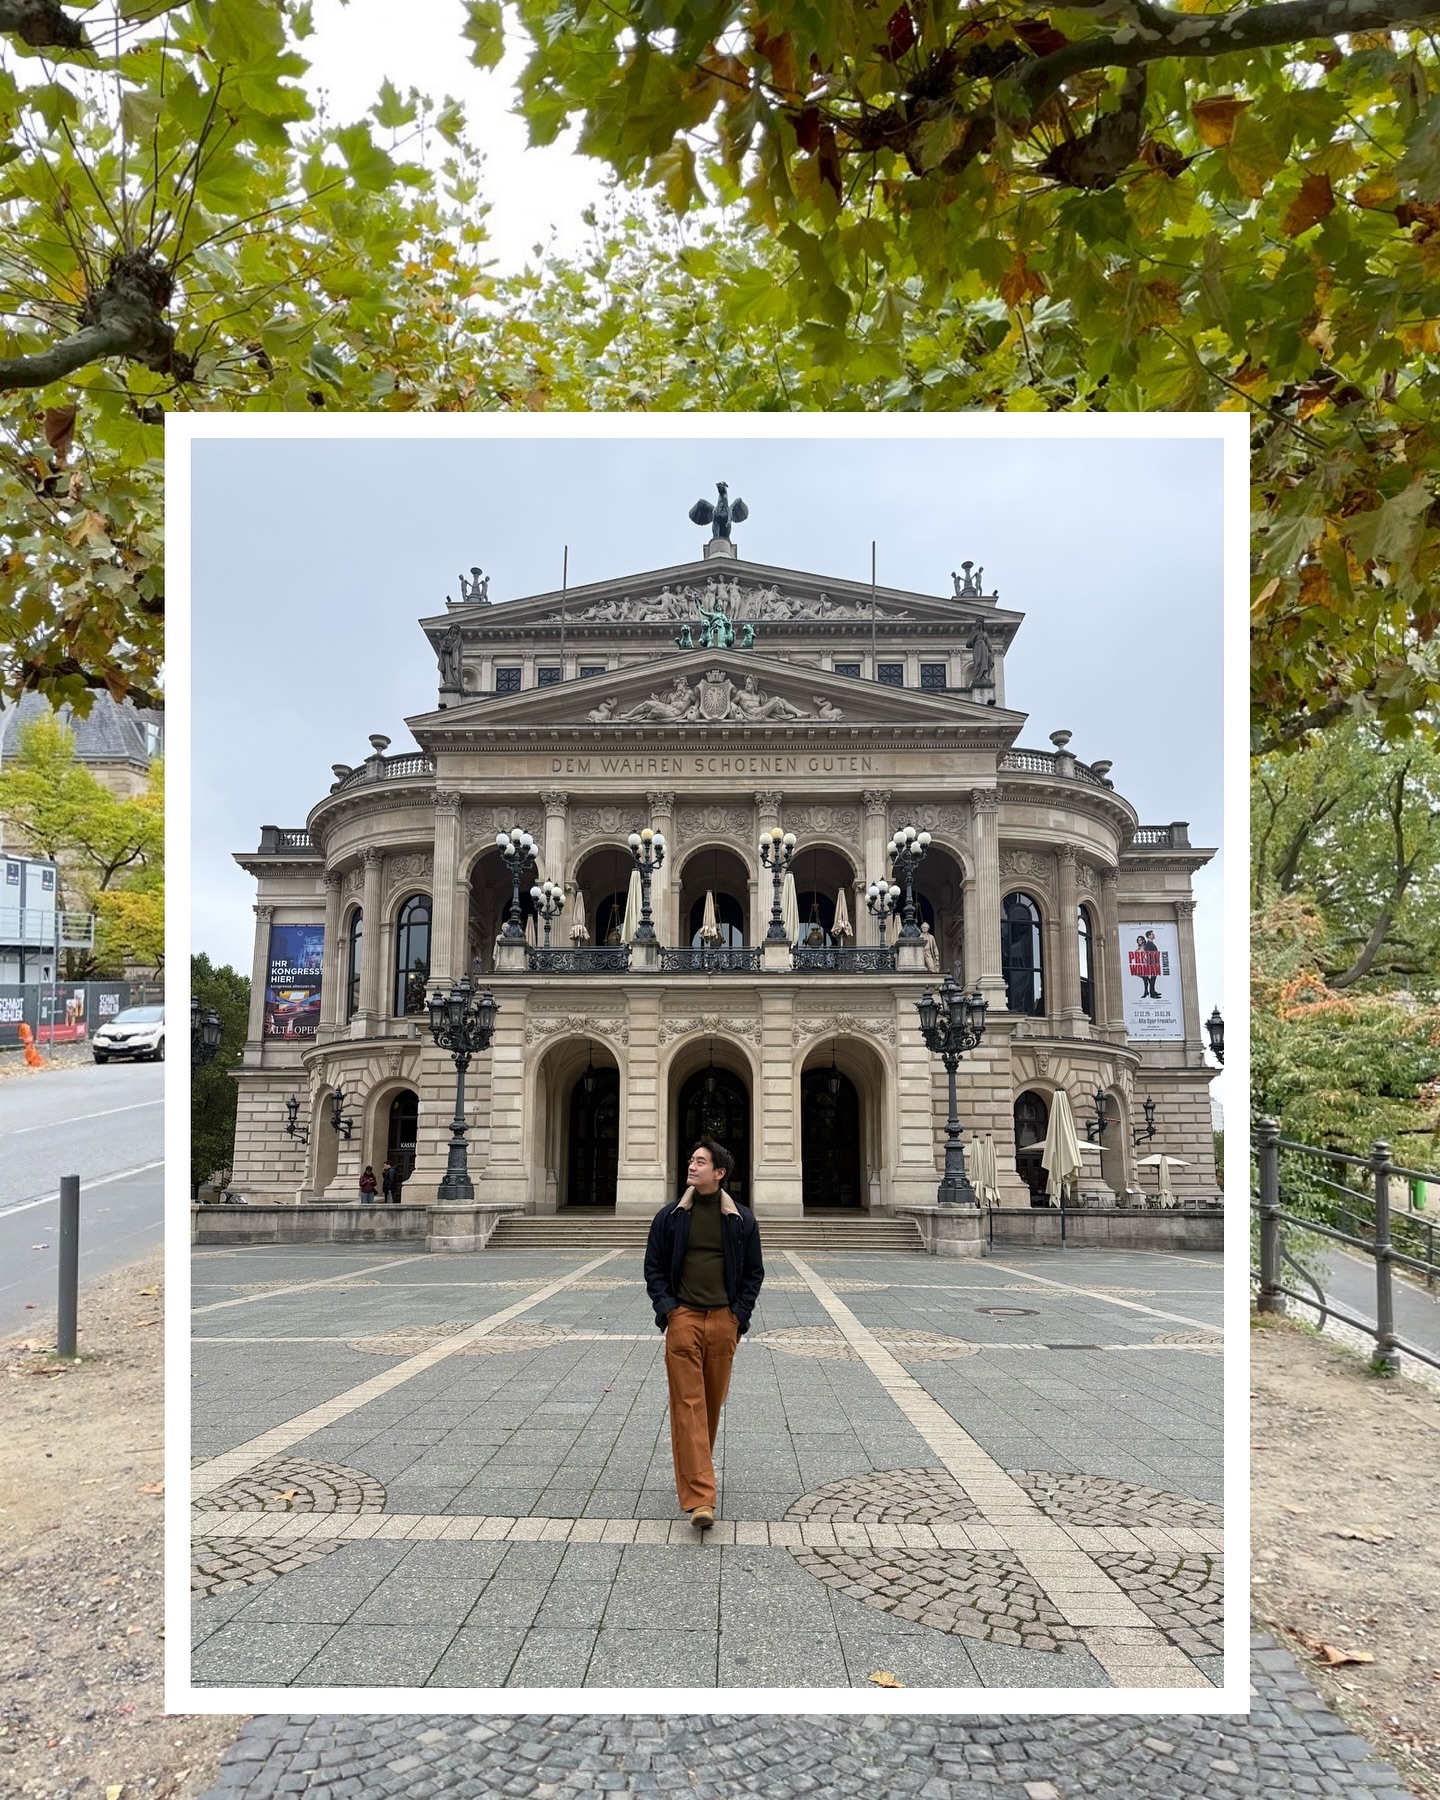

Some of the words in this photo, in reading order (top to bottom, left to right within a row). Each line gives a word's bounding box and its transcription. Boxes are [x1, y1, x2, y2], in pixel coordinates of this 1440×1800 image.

[552, 758, 591, 773] DEM
[600, 758, 683, 773] WAHREN
[694, 757, 797, 773] SCHOENEN
[808, 756, 879, 771] GUTEN.
[1128, 951, 1161, 964] PRETTY
[1129, 964, 1161, 976] WOMAN
[269, 1026, 292, 1034] ALTE
